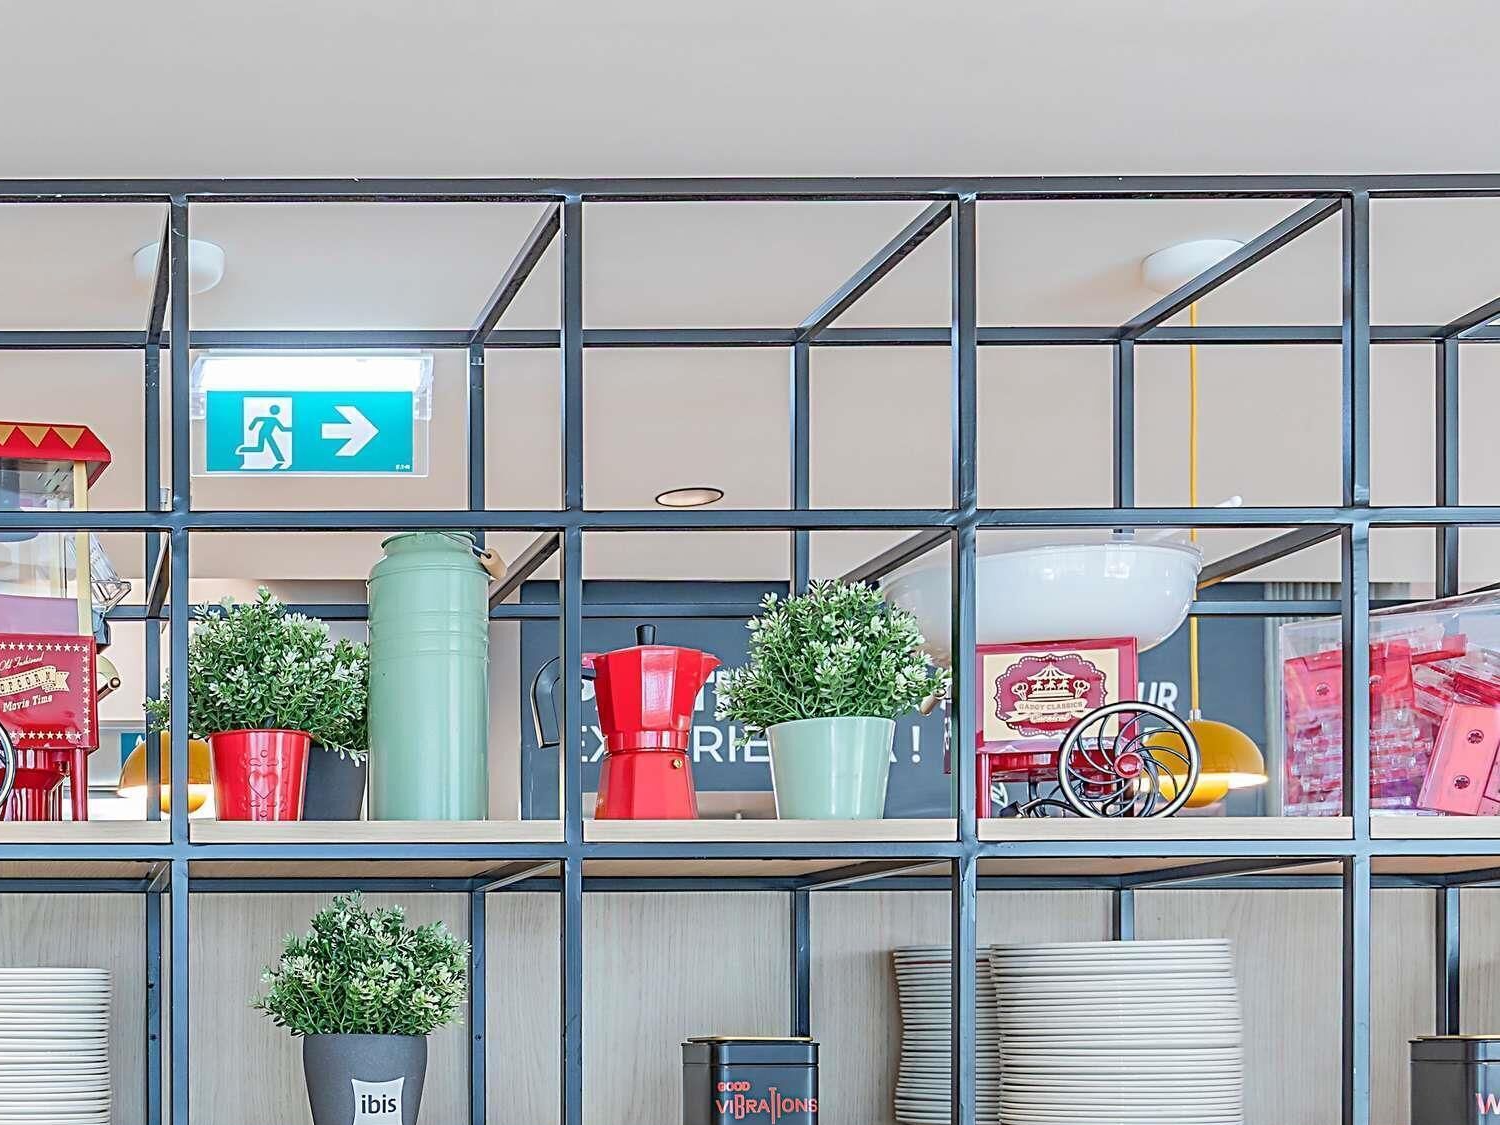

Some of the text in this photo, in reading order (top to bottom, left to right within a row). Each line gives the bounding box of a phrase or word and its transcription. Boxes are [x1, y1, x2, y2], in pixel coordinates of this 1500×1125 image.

[3, 694, 53, 713] Movie Time
[717, 1081, 751, 1092] GOOD
[361, 1094, 397, 1114] ibis
[715, 1086, 818, 1125] VIBRATIONS
